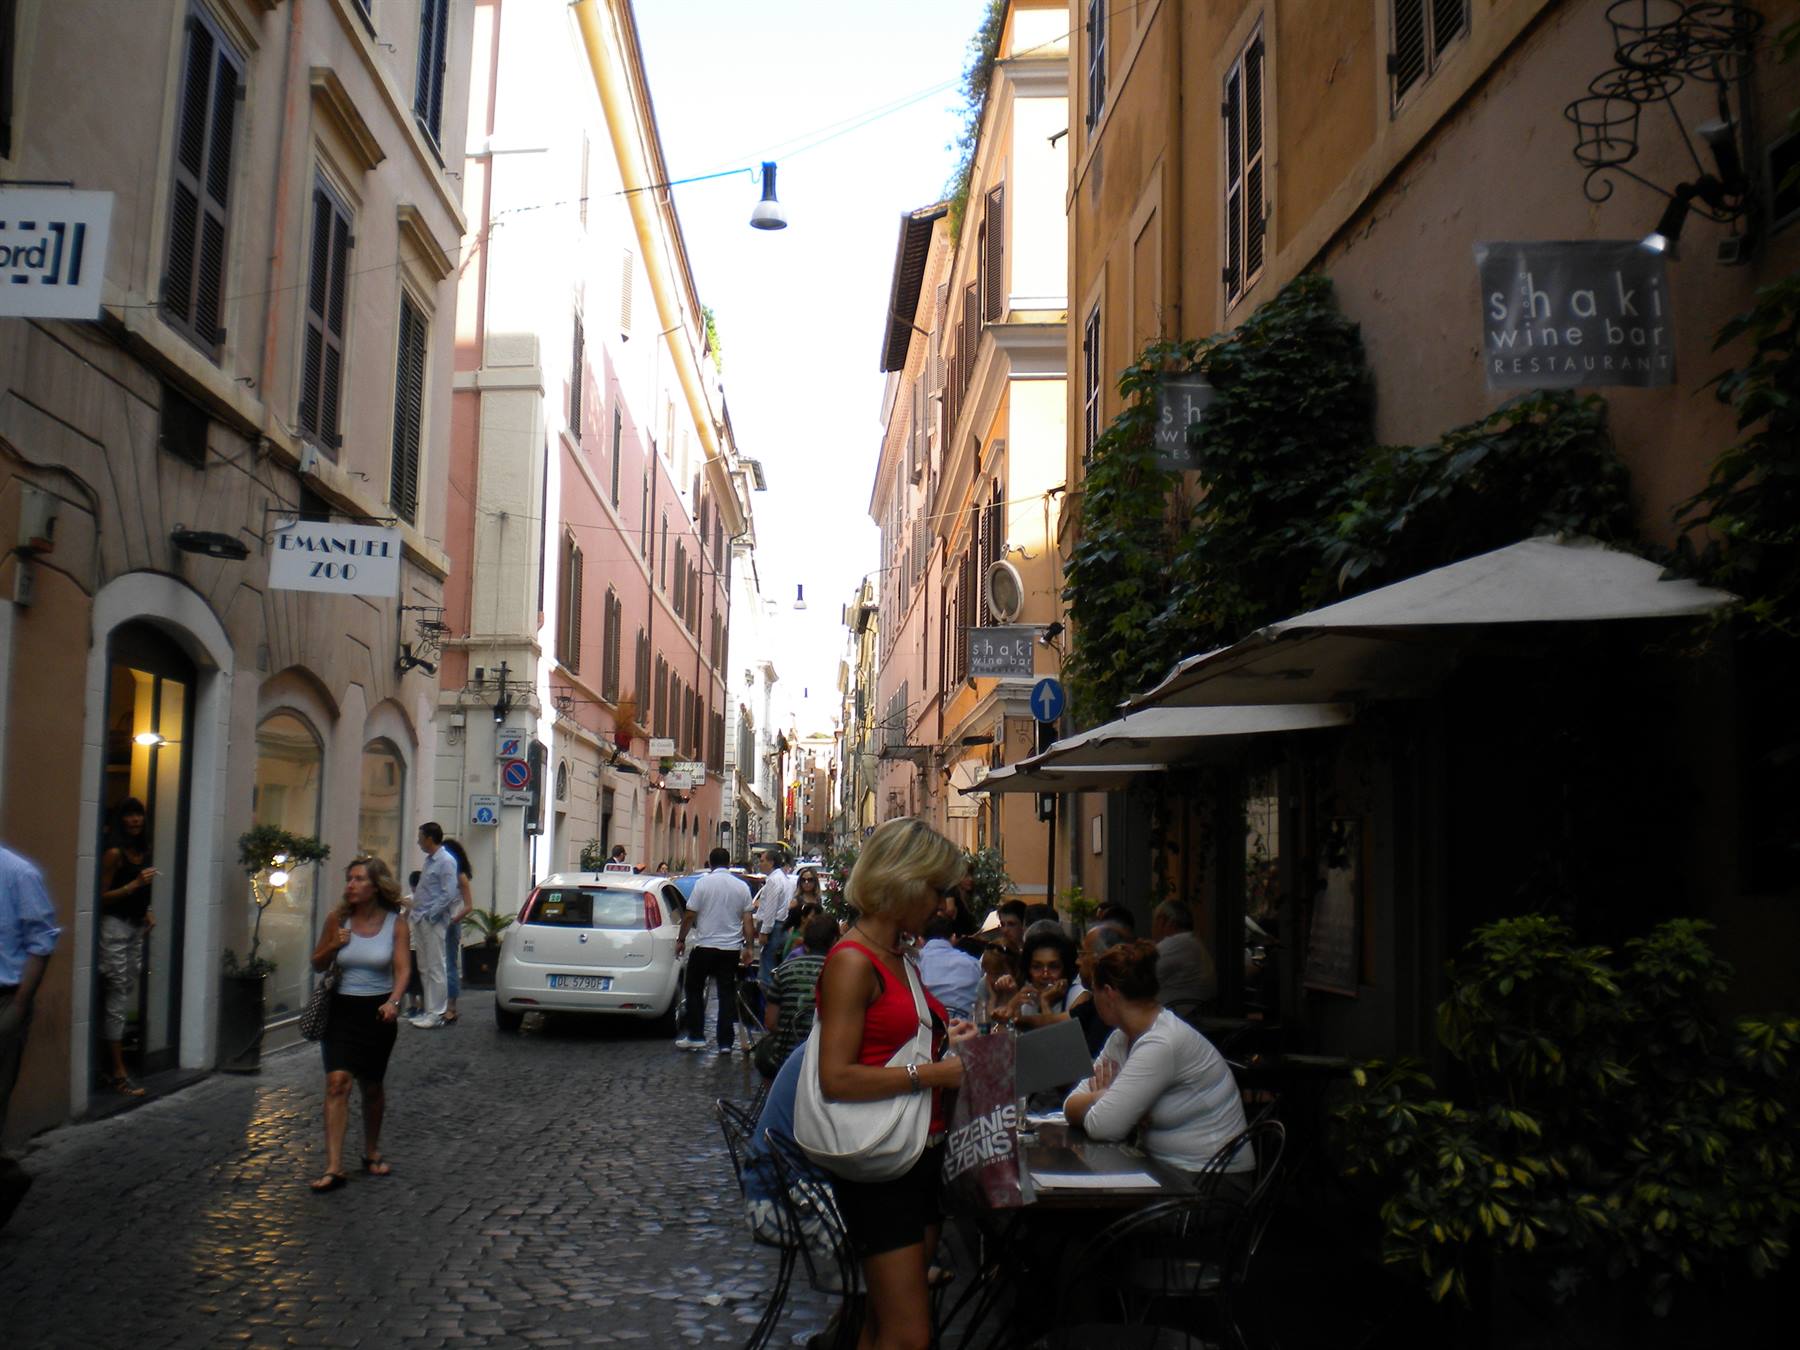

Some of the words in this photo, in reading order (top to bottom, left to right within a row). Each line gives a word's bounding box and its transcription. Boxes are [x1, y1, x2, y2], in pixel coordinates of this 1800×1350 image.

[1490, 271, 1661, 320] shaki
[1492, 322, 1583, 348] wine
[1606, 318, 1664, 345] bar
[1494, 355, 1668, 374] RESTAURANT
[279, 534, 394, 558] EMANUEL
[308, 561, 357, 580] ZOO
[972, 639, 1032, 656] shaki
[972, 655, 1003, 665] wine
[1010, 655, 1032, 665] bar
[947, 1104, 1017, 1155] EZENIS
